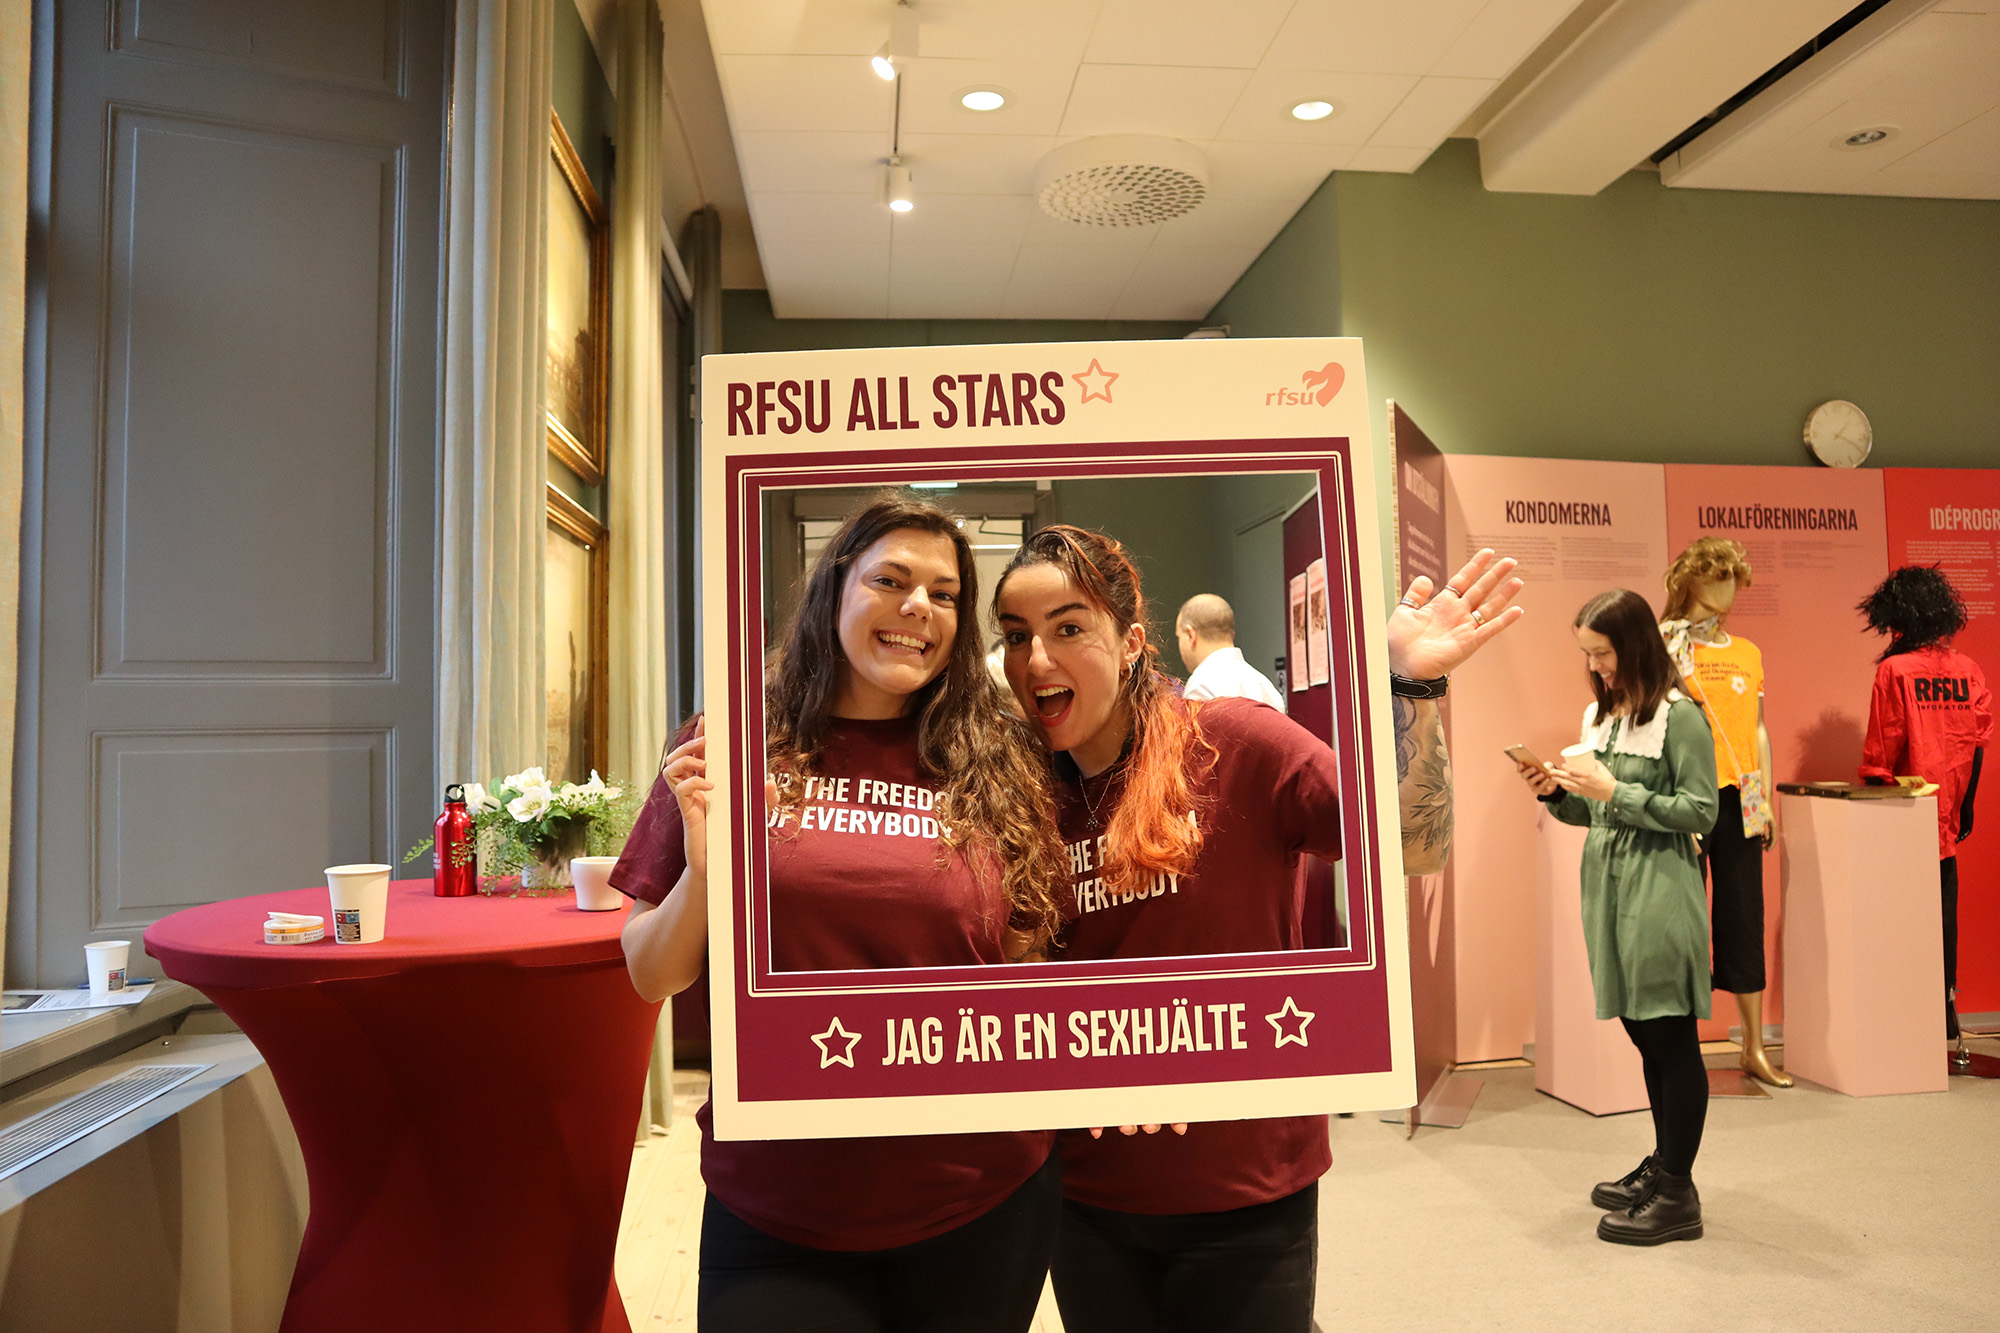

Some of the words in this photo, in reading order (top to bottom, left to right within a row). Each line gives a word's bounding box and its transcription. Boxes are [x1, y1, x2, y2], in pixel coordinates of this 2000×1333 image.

[727, 379, 831, 437] RFSU
[846, 376, 920, 432] ALL
[932, 371, 1066, 429] STARS
[1265, 387, 1315, 407] rfsu
[1505, 500, 1612, 527] KONDOMERNA
[1698, 503, 1859, 531] LOKALFÖRENINGARNA
[1914, 677, 1970, 702] RFSU
[802, 775, 851, 803] THE
[857, 778, 953, 815] FREEDO
[1066, 838, 1093, 876] HE
[1072, 870, 1179, 915] VERYBODY
[882, 1016, 944, 1066] JAG
[955, 1008, 1003, 1063] ÄR
[1015, 1012, 1057, 1060] EN
[1068, 998, 1248, 1058] SEXHJÄLTE
